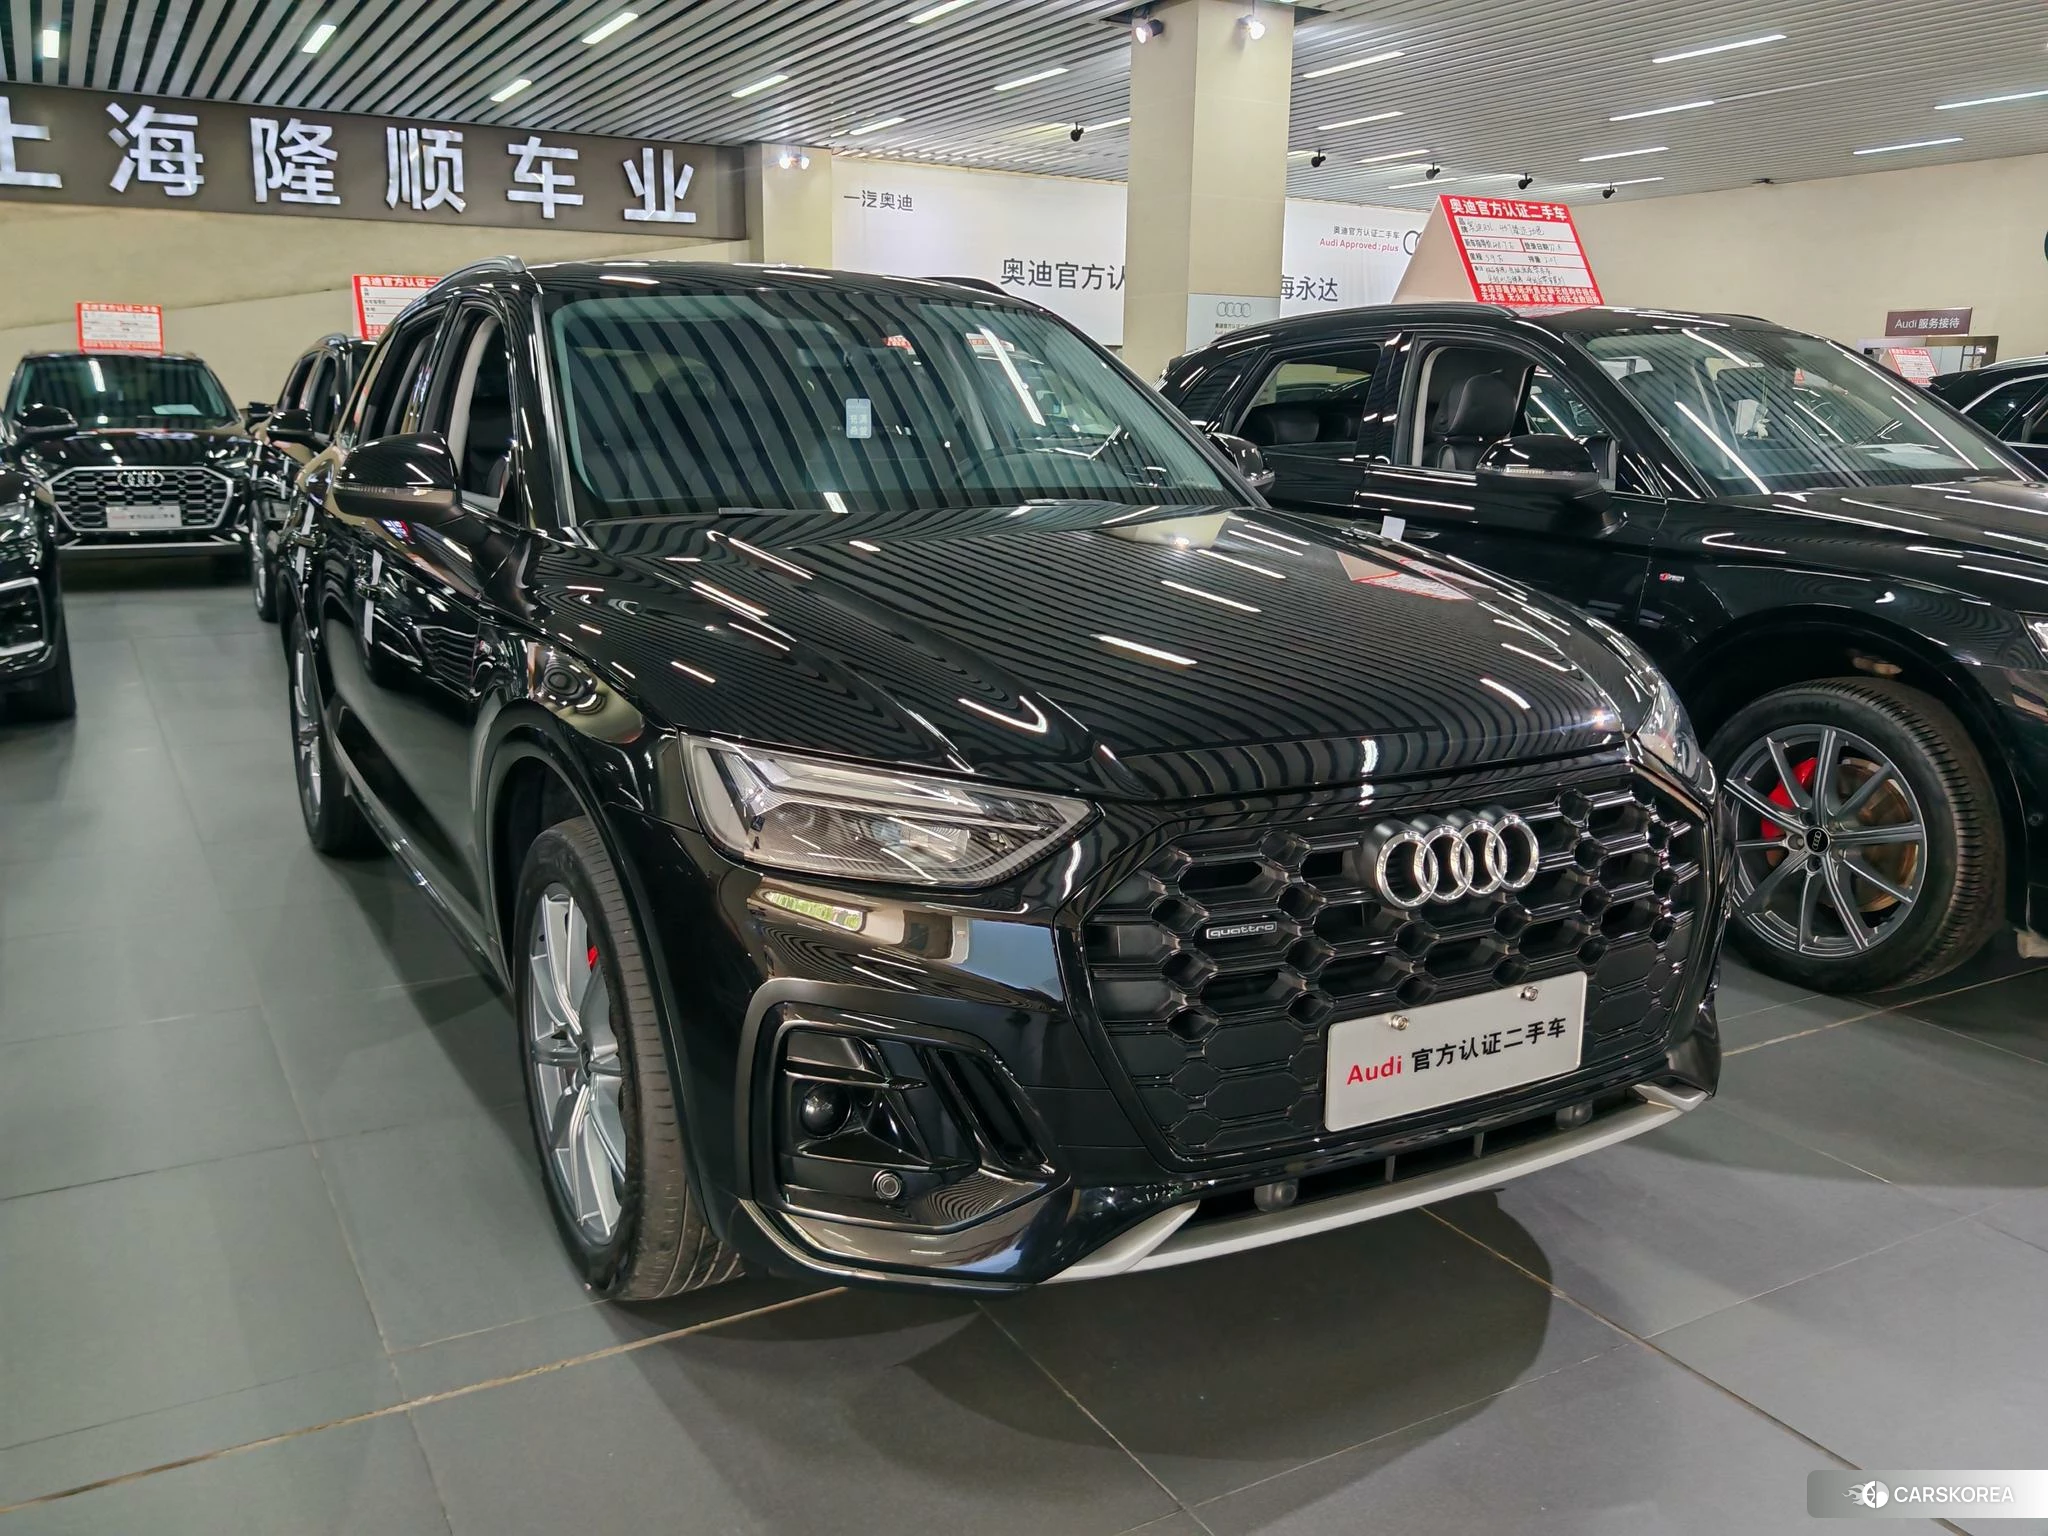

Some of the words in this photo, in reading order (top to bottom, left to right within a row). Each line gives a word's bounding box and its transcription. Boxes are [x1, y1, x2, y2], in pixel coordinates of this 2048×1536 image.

[0, 96, 696, 223] 上海隆顺车业
[843, 190, 914, 212] 一汽奥迪
[1450, 198, 1568, 221] 奥迪官方认证二手车
[1333, 226, 1400, 239] 奥迪官方认证二手车
[1319, 239, 1339, 247] Audi
[1340, 239, 1377, 252] Approved
[1895, 319, 1917, 329] Audi
[1918, 317, 1960, 329] 服务接待
[1210, 924, 1275, 938] quattro
[1346, 1055, 1402, 1085] Audi
[1411, 1017, 1567, 1073] 官方认证二手车
